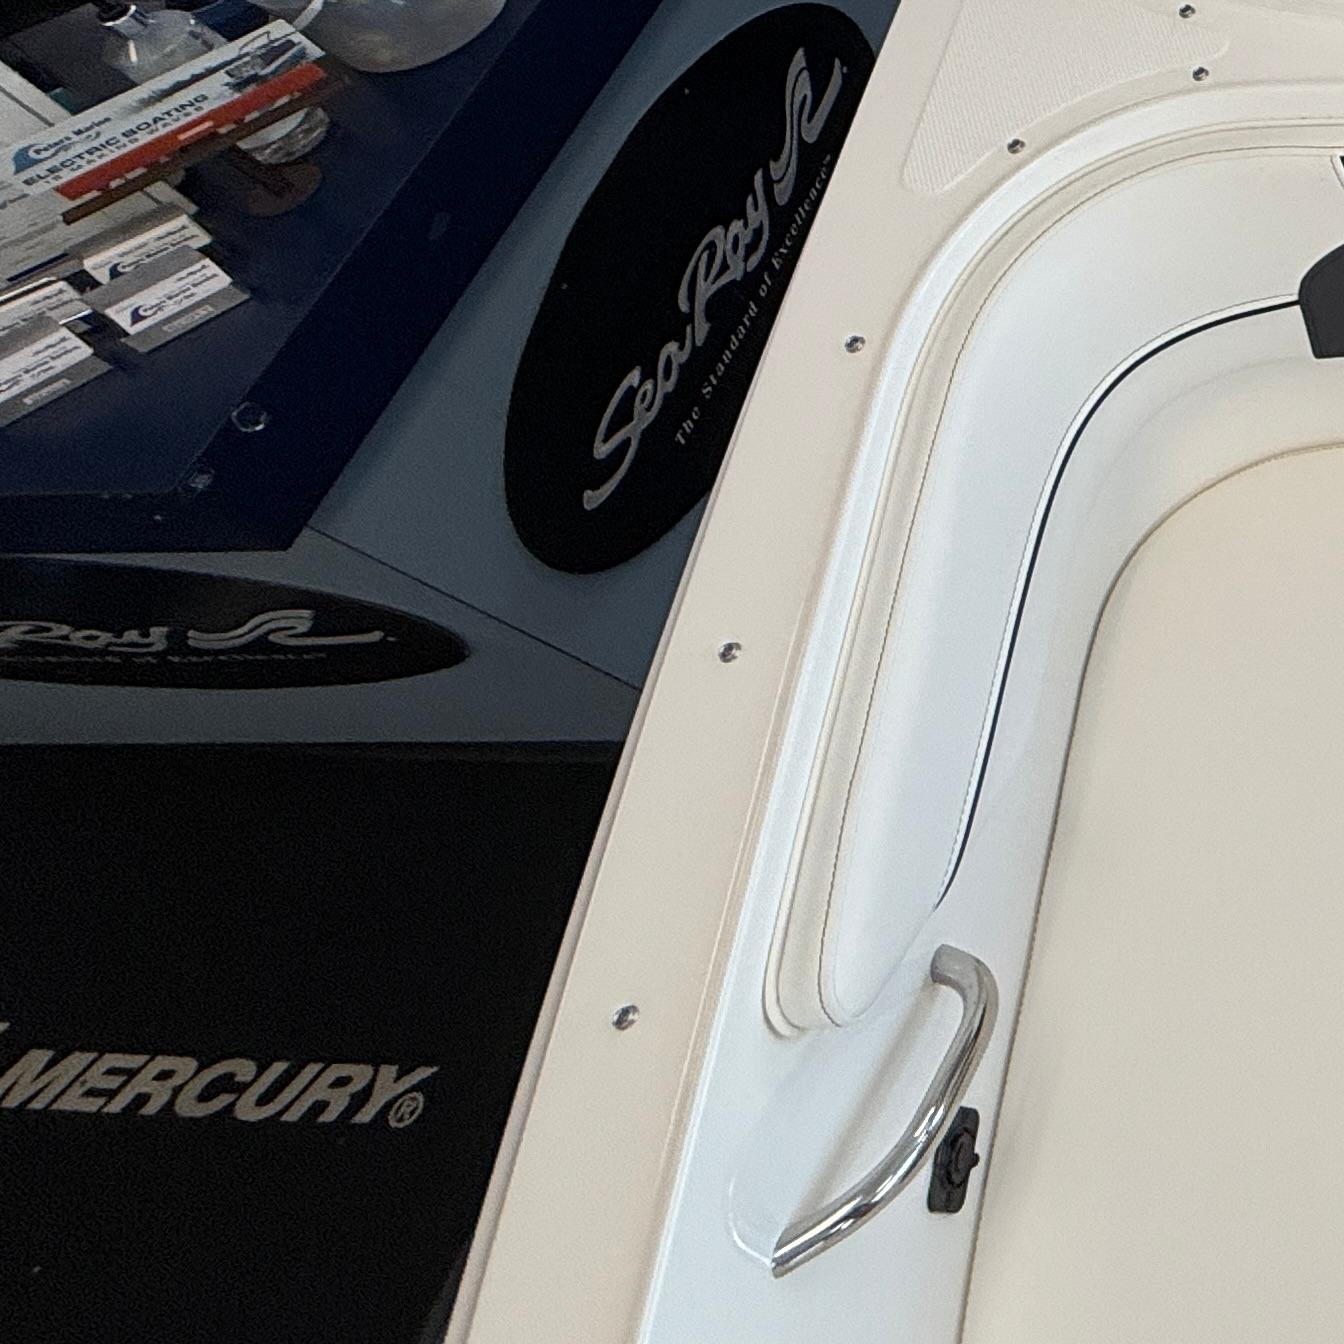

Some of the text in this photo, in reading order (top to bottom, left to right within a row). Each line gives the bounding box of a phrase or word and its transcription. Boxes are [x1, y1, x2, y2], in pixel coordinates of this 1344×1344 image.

[22, 137, 121, 186] ELECTRIC
[122, 93, 208, 138] BOATING
[583, 168, 769, 511] Sea Ray
[700, 300, 758, 399] Standard
